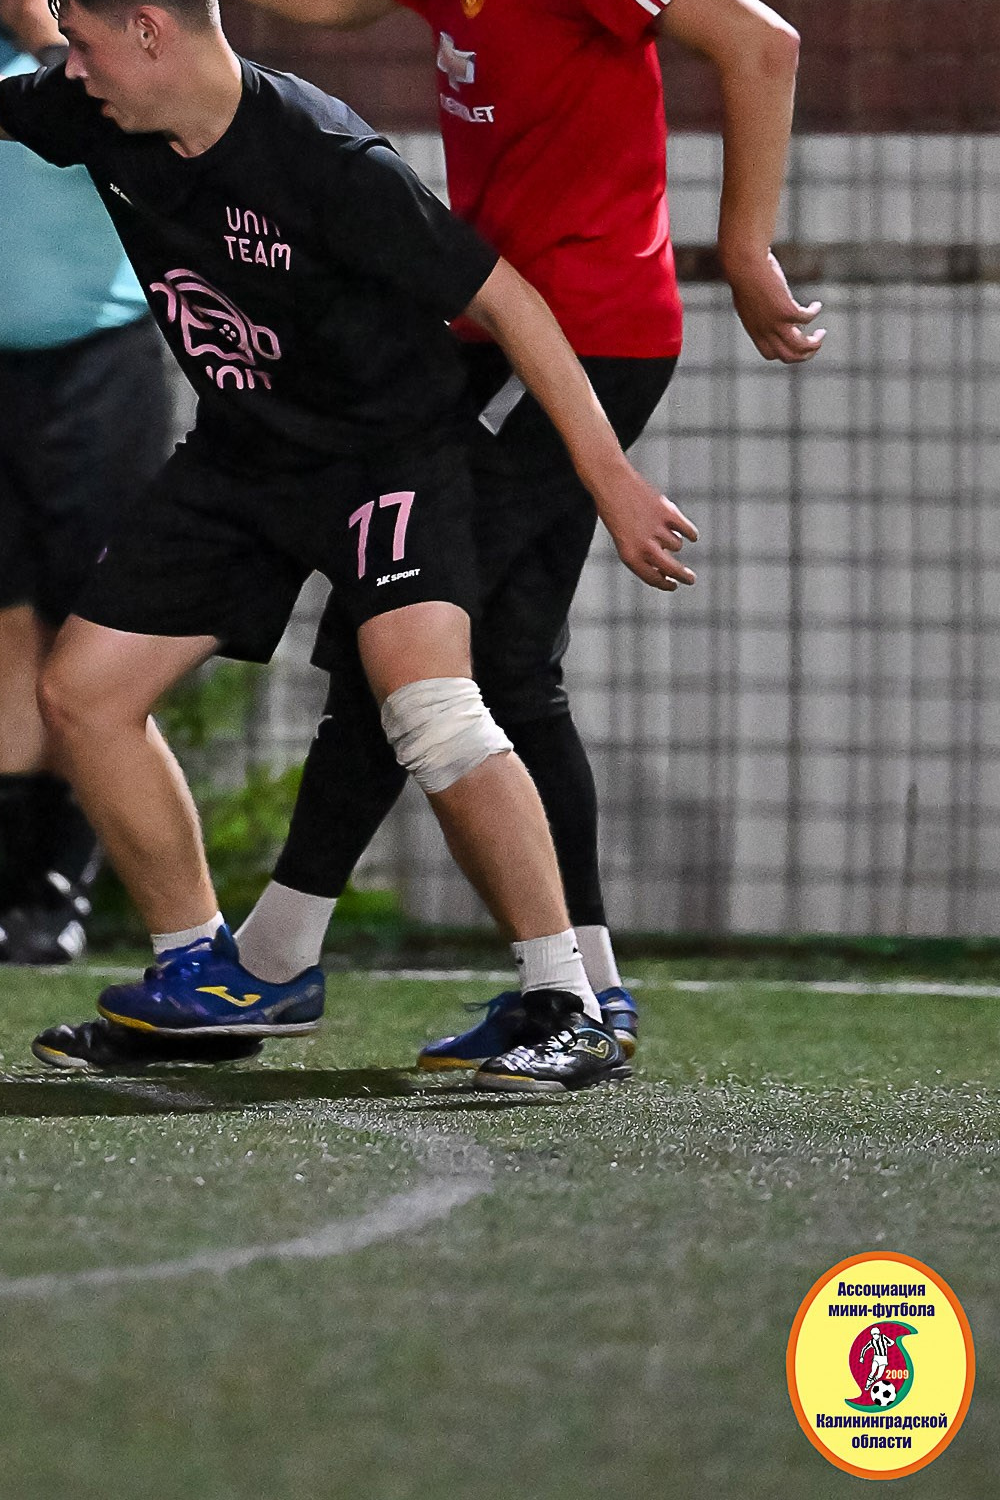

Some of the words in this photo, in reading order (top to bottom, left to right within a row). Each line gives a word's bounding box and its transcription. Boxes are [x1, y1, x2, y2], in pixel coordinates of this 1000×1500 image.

[226, 205, 281, 238] UNI
[223, 235, 292, 271] TEAM
[348, 490, 416, 580] 17
[391, 568, 421, 582] SPORT
